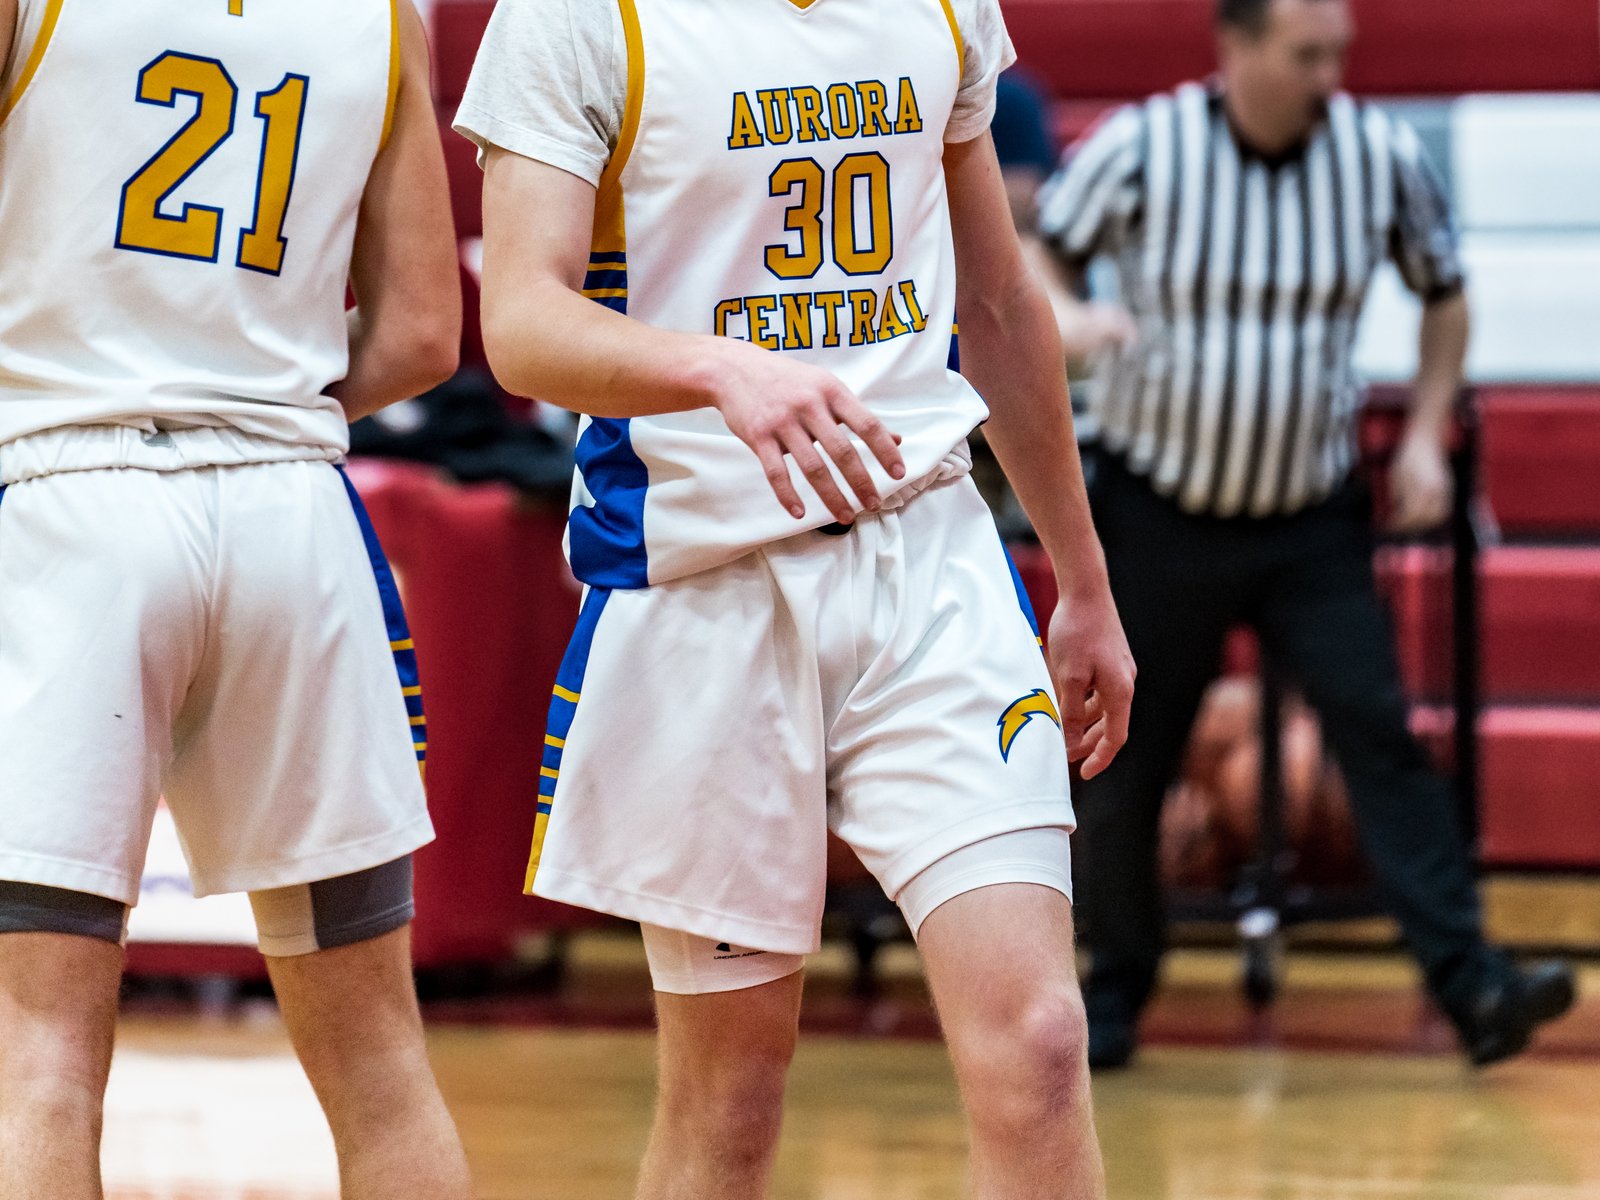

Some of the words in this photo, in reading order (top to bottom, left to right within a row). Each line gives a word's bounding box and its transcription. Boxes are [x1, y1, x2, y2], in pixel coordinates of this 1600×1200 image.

[114, 49, 310, 277] 21
[727, 76, 923, 150] AURORA
[764, 151, 894, 280] 30
[714, 279, 929, 351] CENTRAL
